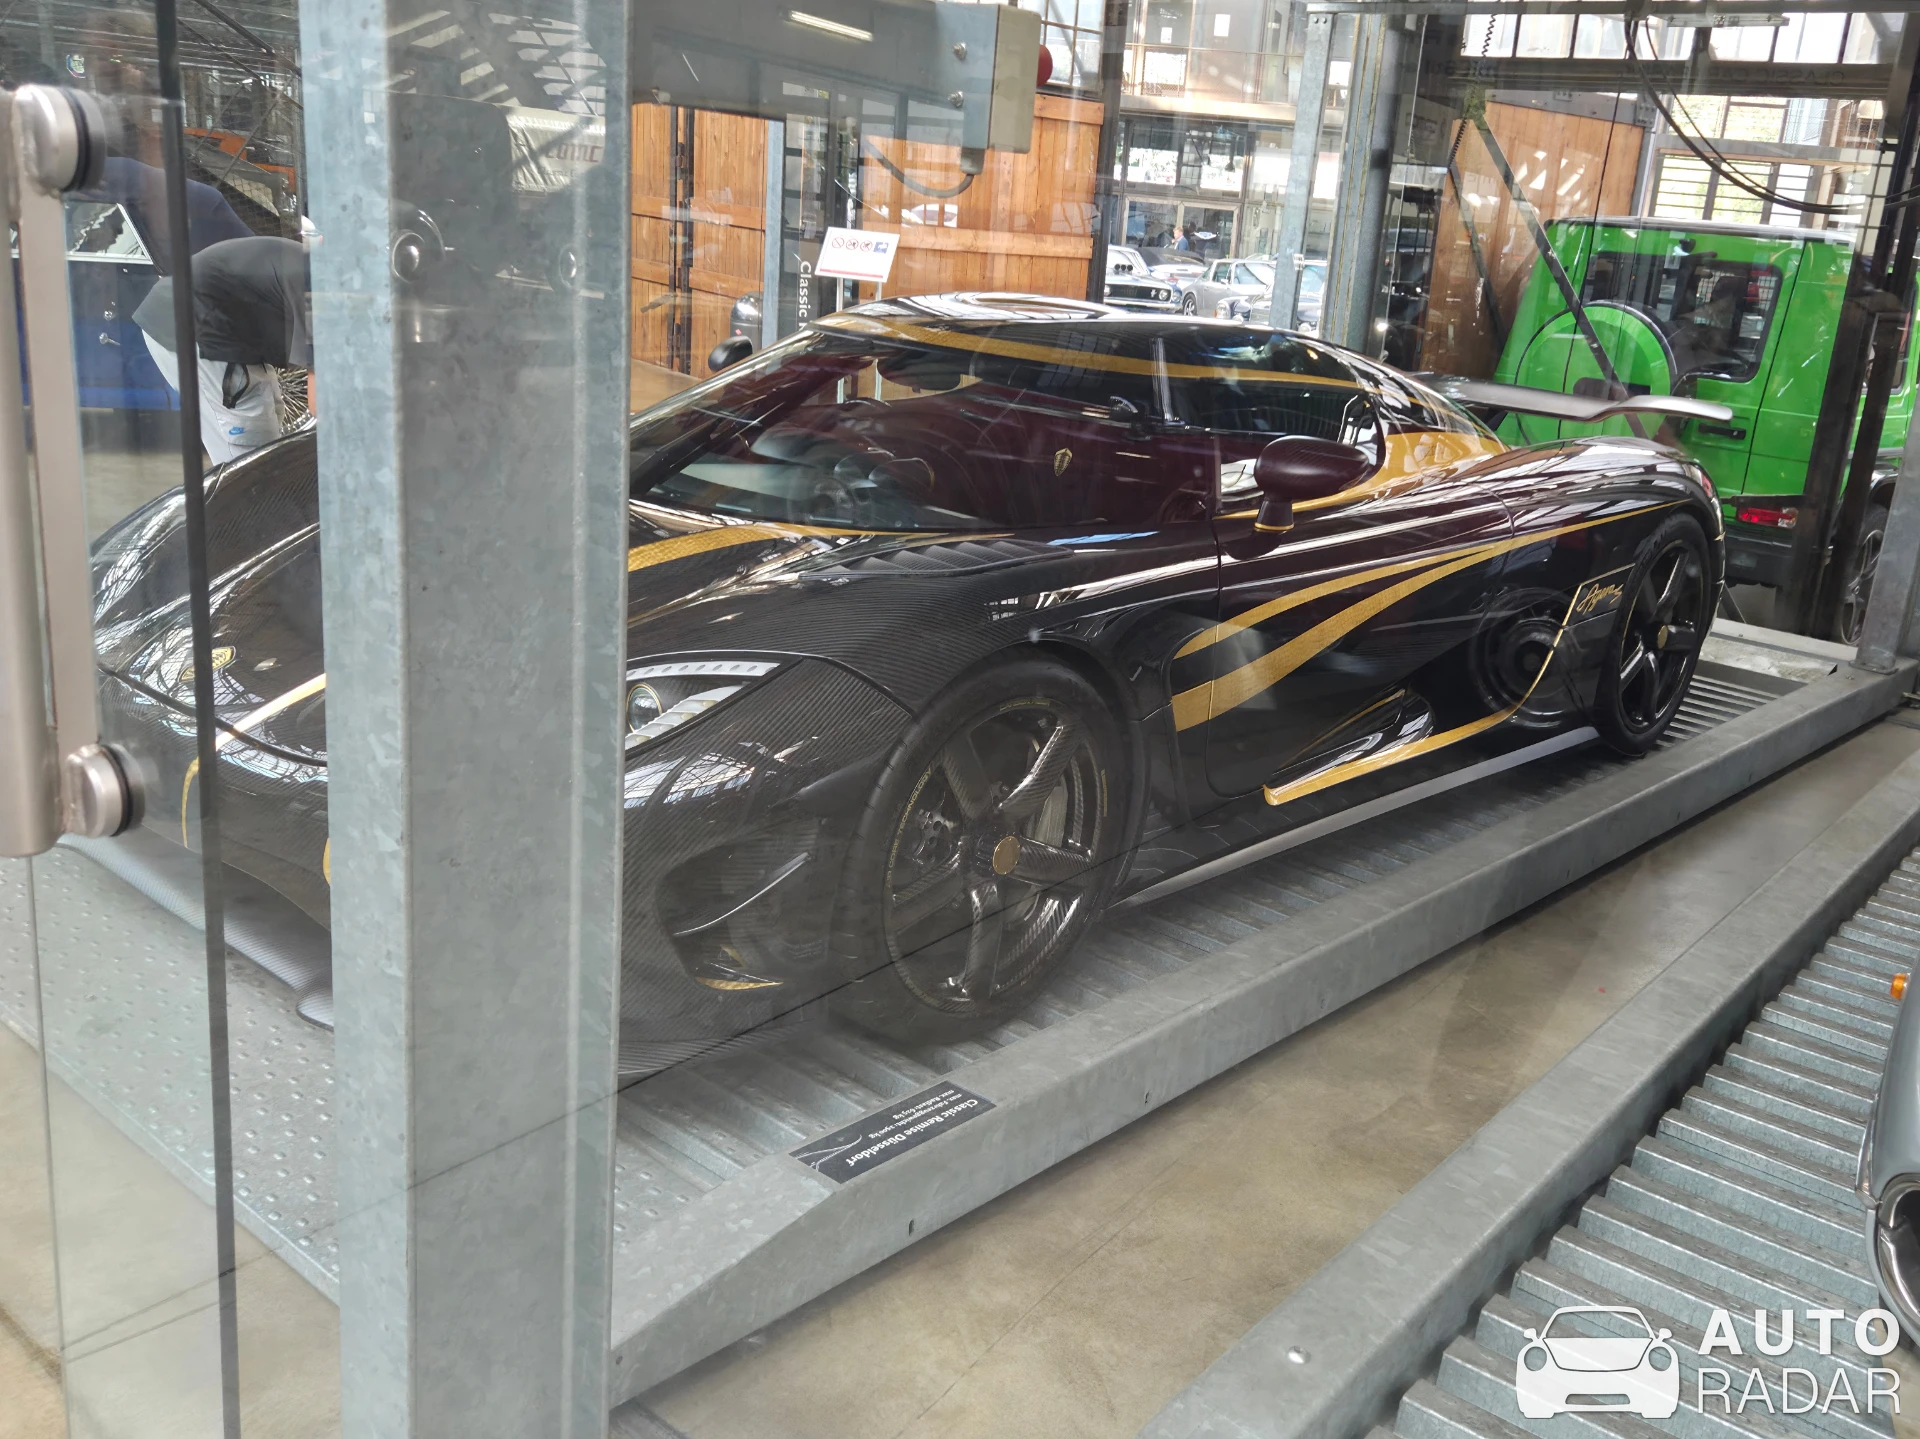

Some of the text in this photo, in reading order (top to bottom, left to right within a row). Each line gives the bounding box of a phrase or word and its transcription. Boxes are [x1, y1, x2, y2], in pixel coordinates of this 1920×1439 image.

[798, 261, 812, 318] Classic
[896, 766, 933, 836] TECHNOLOGY
[845, 1098, 979, 1167] Classic Remise Düsseldorf
[867, 1131, 882, 1140] kg
